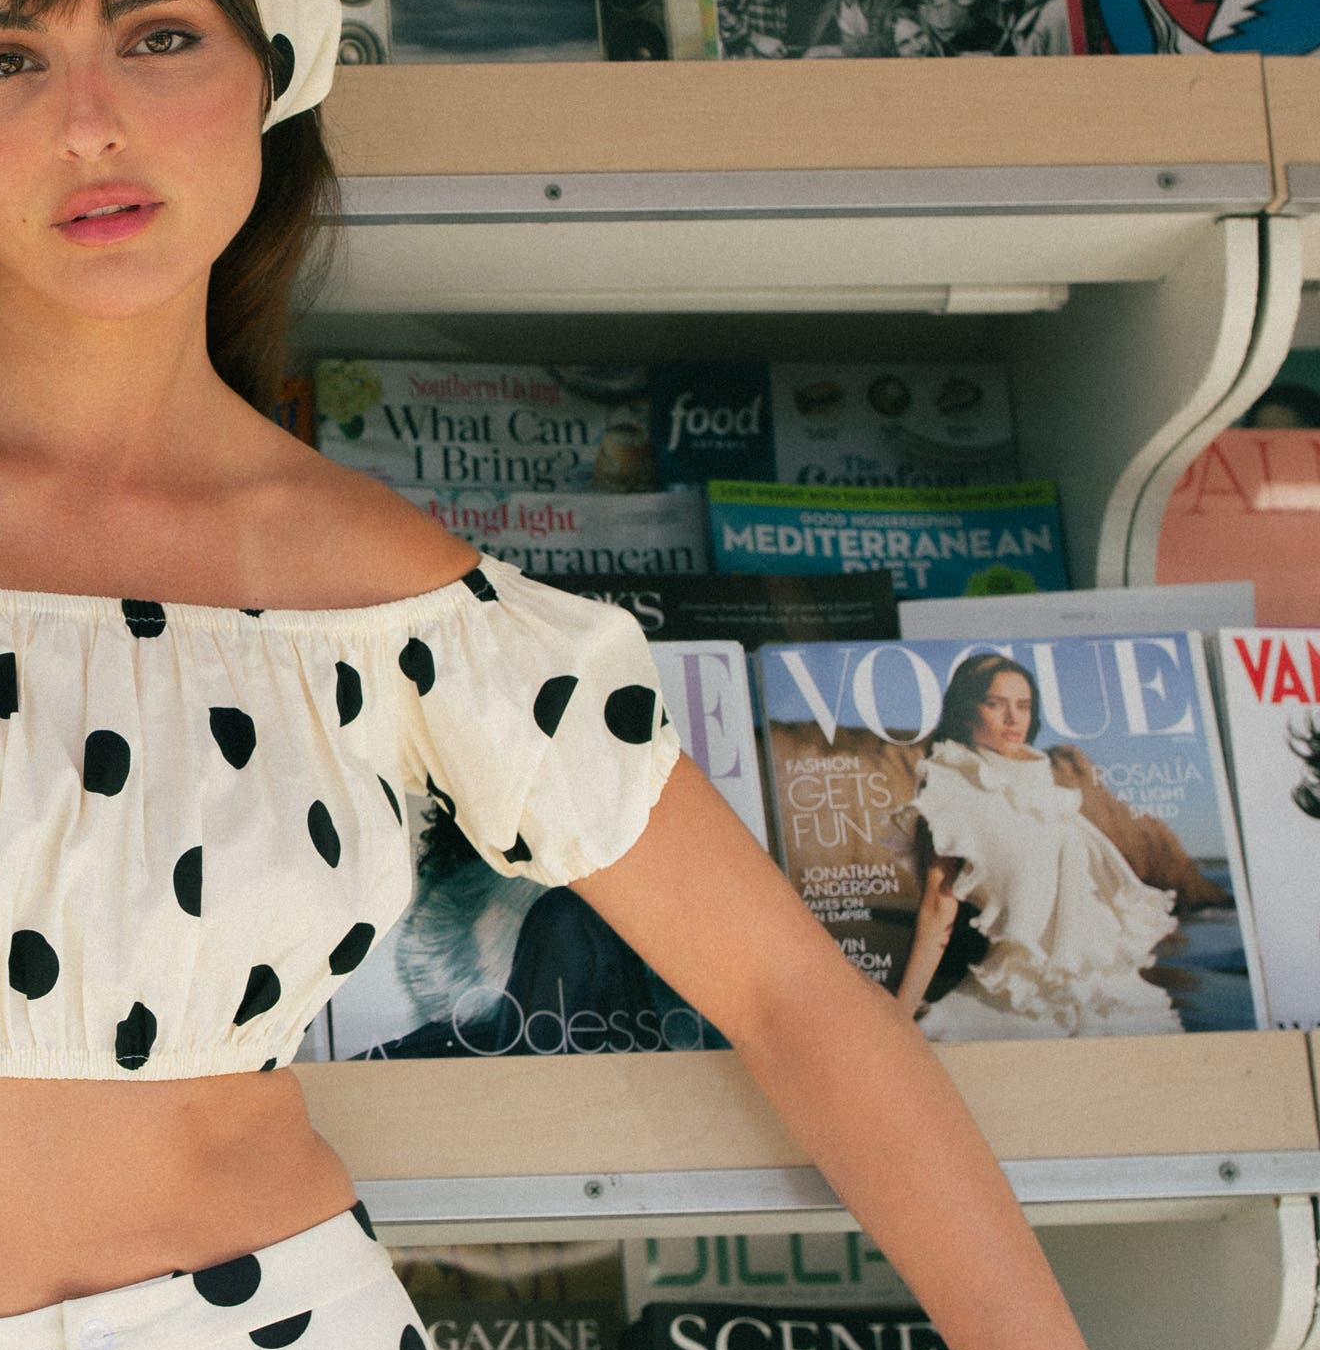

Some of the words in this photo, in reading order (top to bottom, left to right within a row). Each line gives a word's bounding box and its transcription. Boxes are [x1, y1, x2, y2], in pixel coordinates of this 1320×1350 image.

[382, 404, 492, 443] What
[508, 409, 590, 446] Can
[669, 393, 763, 452] food
[443, 446, 580, 491] Bring?
[720, 522, 1052, 560] MEDITERRANEAN
[785, 755, 860, 775] FASHION
[786, 771, 893, 813] GETS
[791, 810, 874, 849] FUN
[799, 862, 896, 884] JONATHAN
[802, 878, 900, 899] ANDERSON
[451, 977, 705, 1057] Odessa
